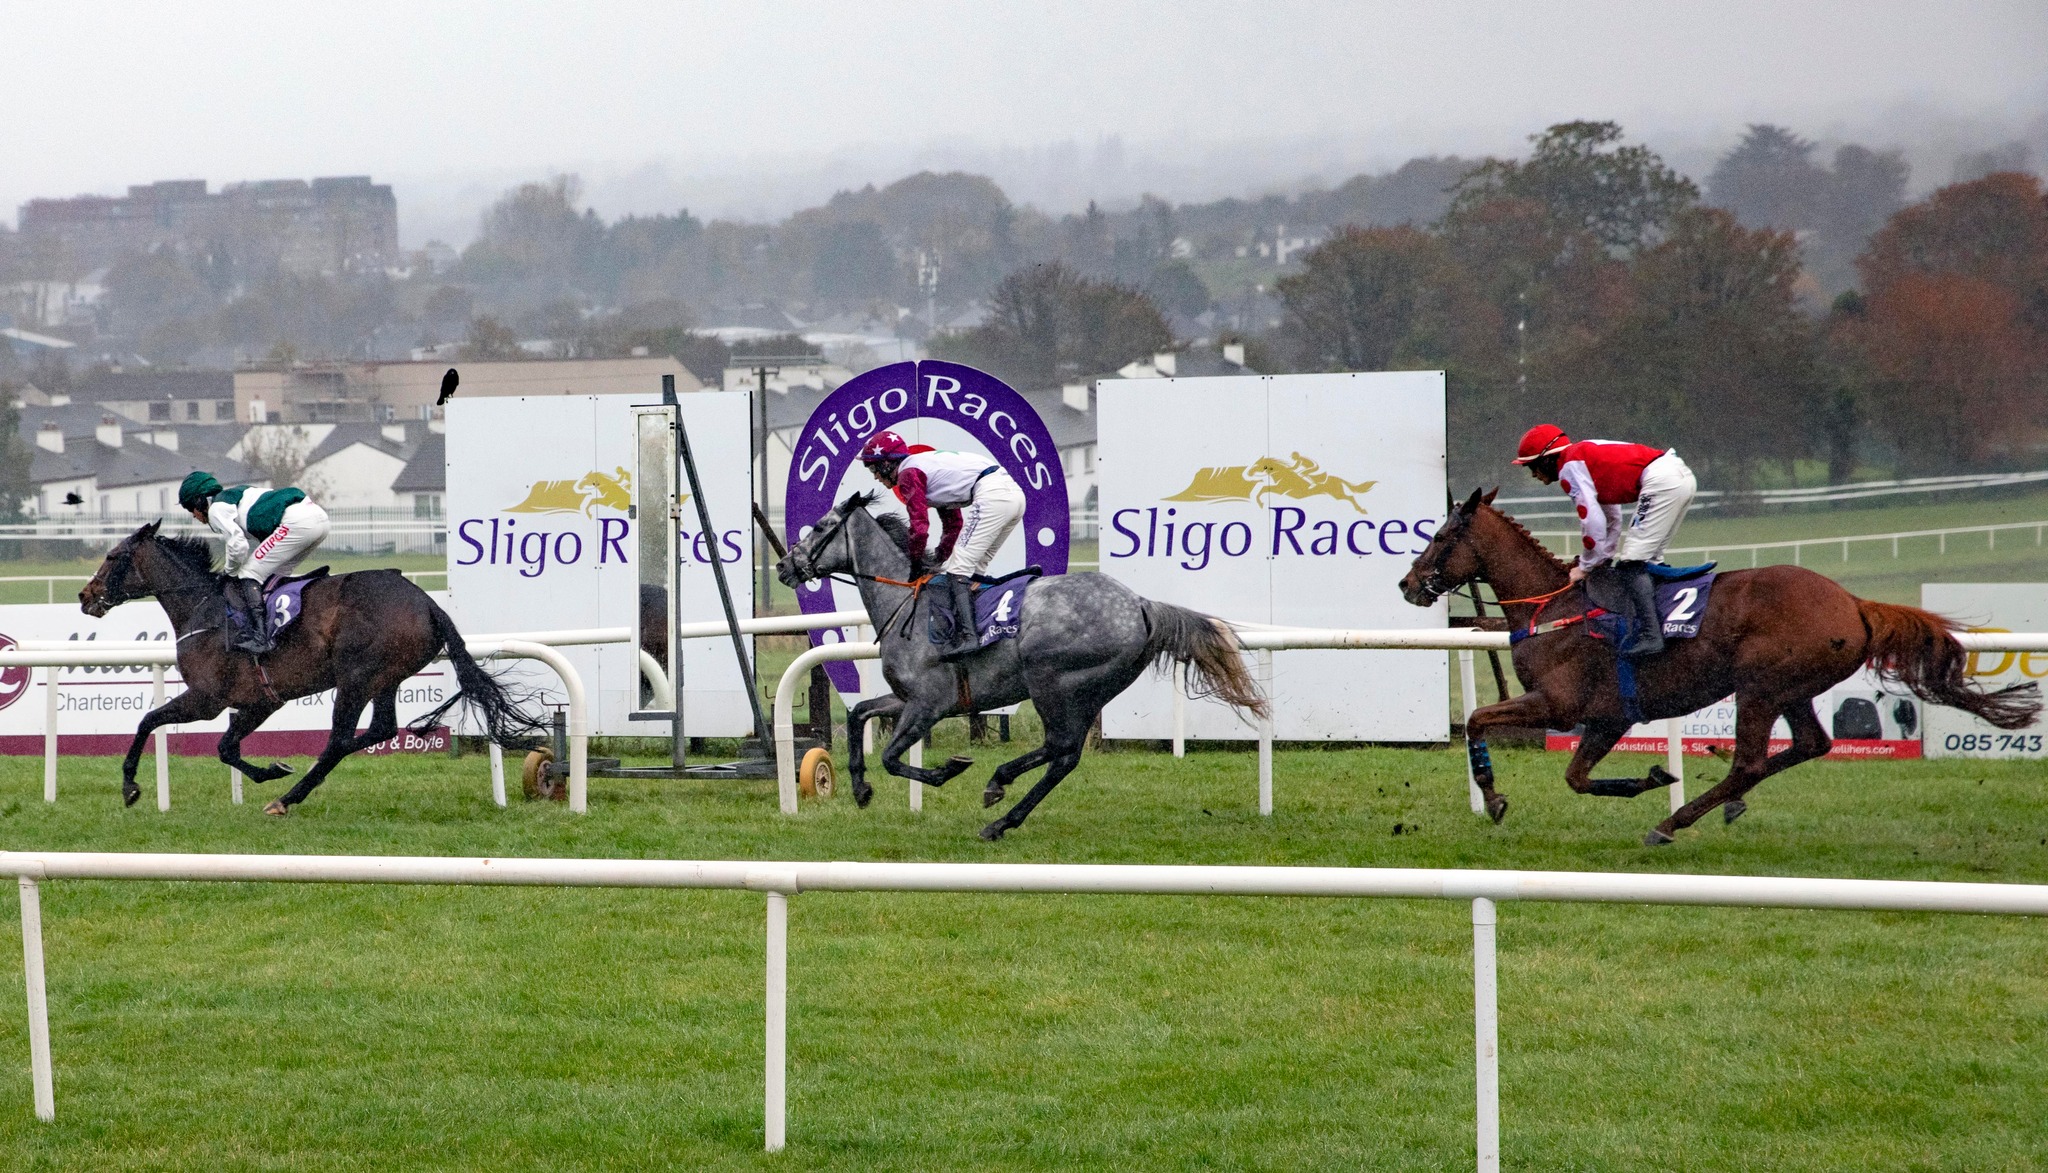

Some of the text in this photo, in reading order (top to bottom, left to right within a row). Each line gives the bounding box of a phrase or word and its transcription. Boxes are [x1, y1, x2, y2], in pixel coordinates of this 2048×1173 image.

[799, 374, 1053, 492] Sligo Races
[456, 517, 743, 578] Sligo Res
[1109, 506, 1436, 571] Sligo Races
[274, 594, 292, 628] 3
[991, 589, 1014, 622] 4
[1666, 587, 1699, 622] 2
[57, 692, 144, 711] Chartered
[404, 734, 444, 752] Boyle
[1611, 741, 1656, 752] ndustrial
[1684, 724, 1710, 736] LED
[1945, 734, 2044, 752] 085 743
